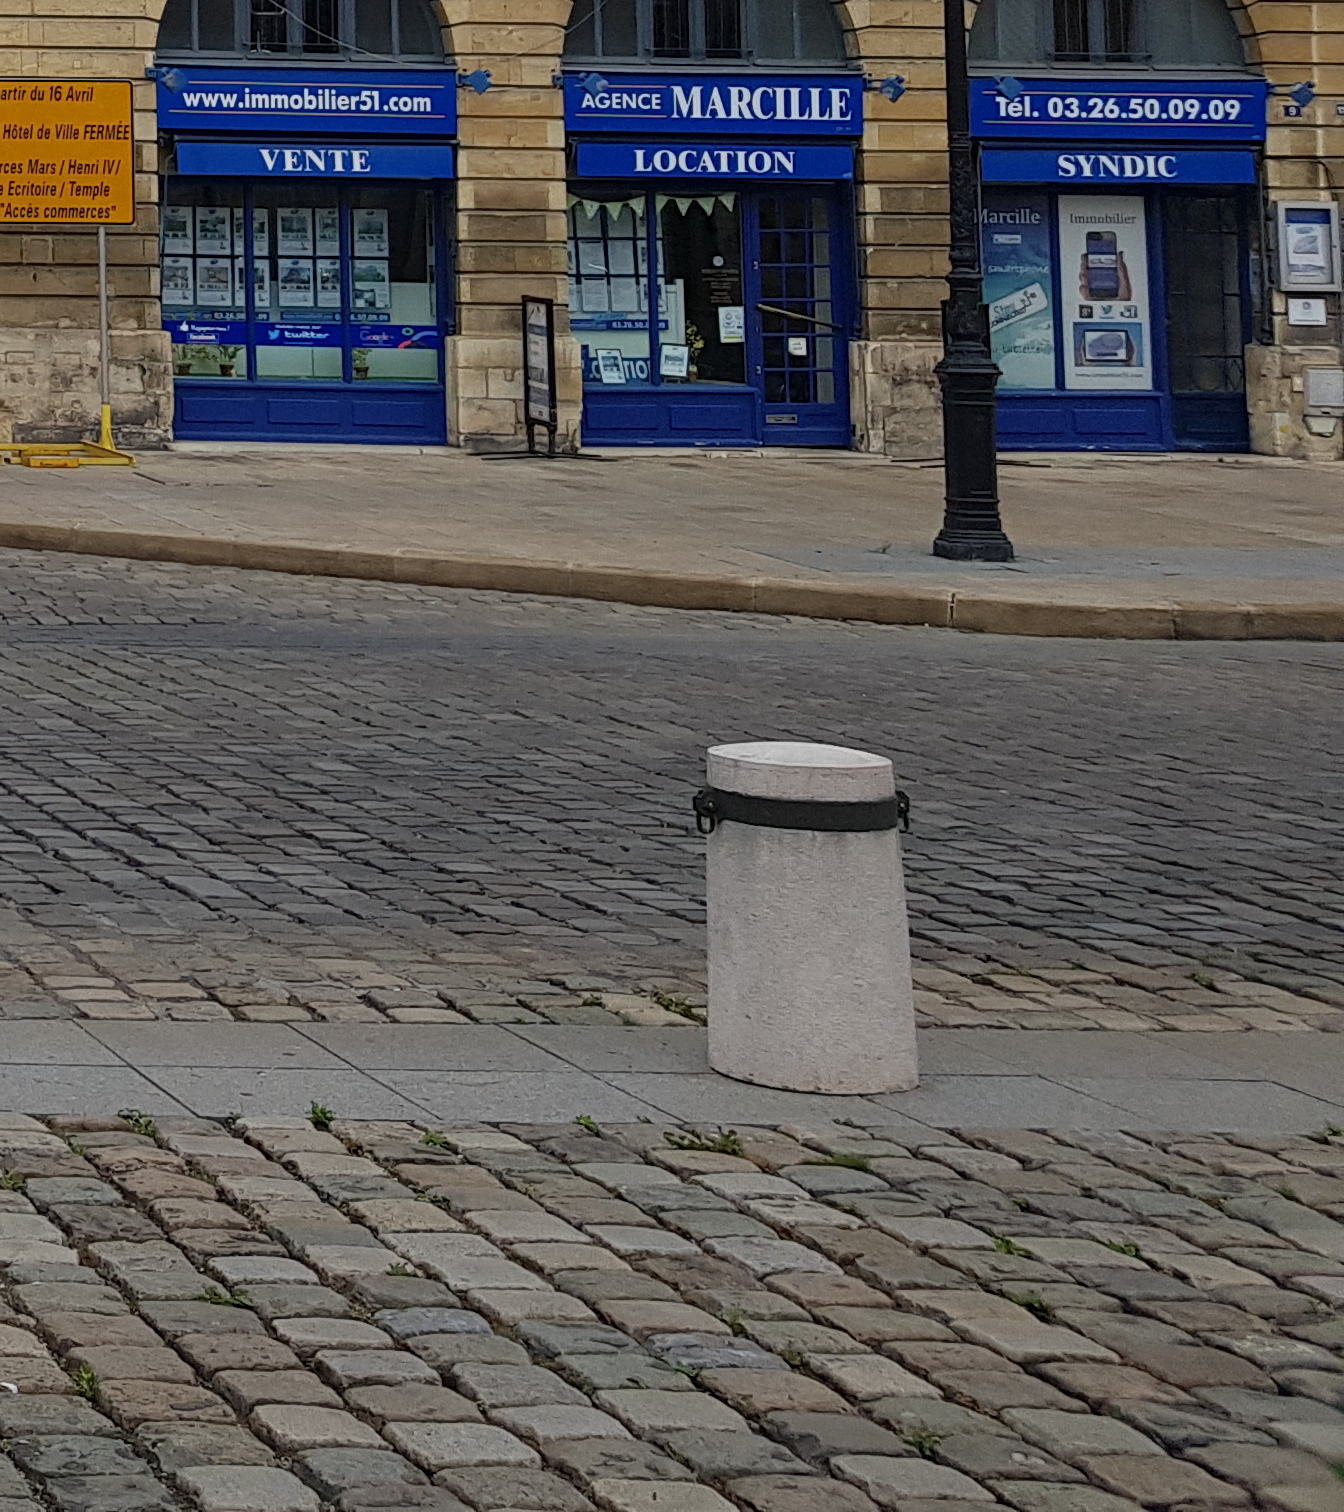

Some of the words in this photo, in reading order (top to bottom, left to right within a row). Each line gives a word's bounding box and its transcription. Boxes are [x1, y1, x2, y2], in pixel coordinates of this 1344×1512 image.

[30, 85, 45, 102] du
[49, 85, 63, 102] 16
[66, 86, 94, 102] Avril
[182, 87, 432, 113] www.immobilier51.com
[580, 92, 662, 110] AGENCE
[669, 85, 853, 121] MARCILLE
[995, 96, 1040, 118] Tél.
[1047, 98, 1242, 120] 03.26.50.09.09
[1288, 106, 1297, 116] 9
[3, 123, 33, 140] Hôtel
[37, 124, 51, 140] de
[55, 124, 79, 140] Ville
[83, 120, 130, 141] FERMÉE
[27, 159, 56, 175] Mars
[67, 159, 100, 175] Henri
[258, 148, 372, 173] VENTE
[633, 149, 796, 174] LOCATION
[1057, 154, 1179, 178] SYNDIC
[7, 180, 57, 197] Ecritoire
[69, 181, 110, 200] Temple
[0, 202, 40, 218] "Accès
[43, 203, 117, 219] commerces"
[973, 208, 1042, 224] Marcille
[1069, 213, 1137, 225] Immobilier
[283, 330, 330, 340] twitter
